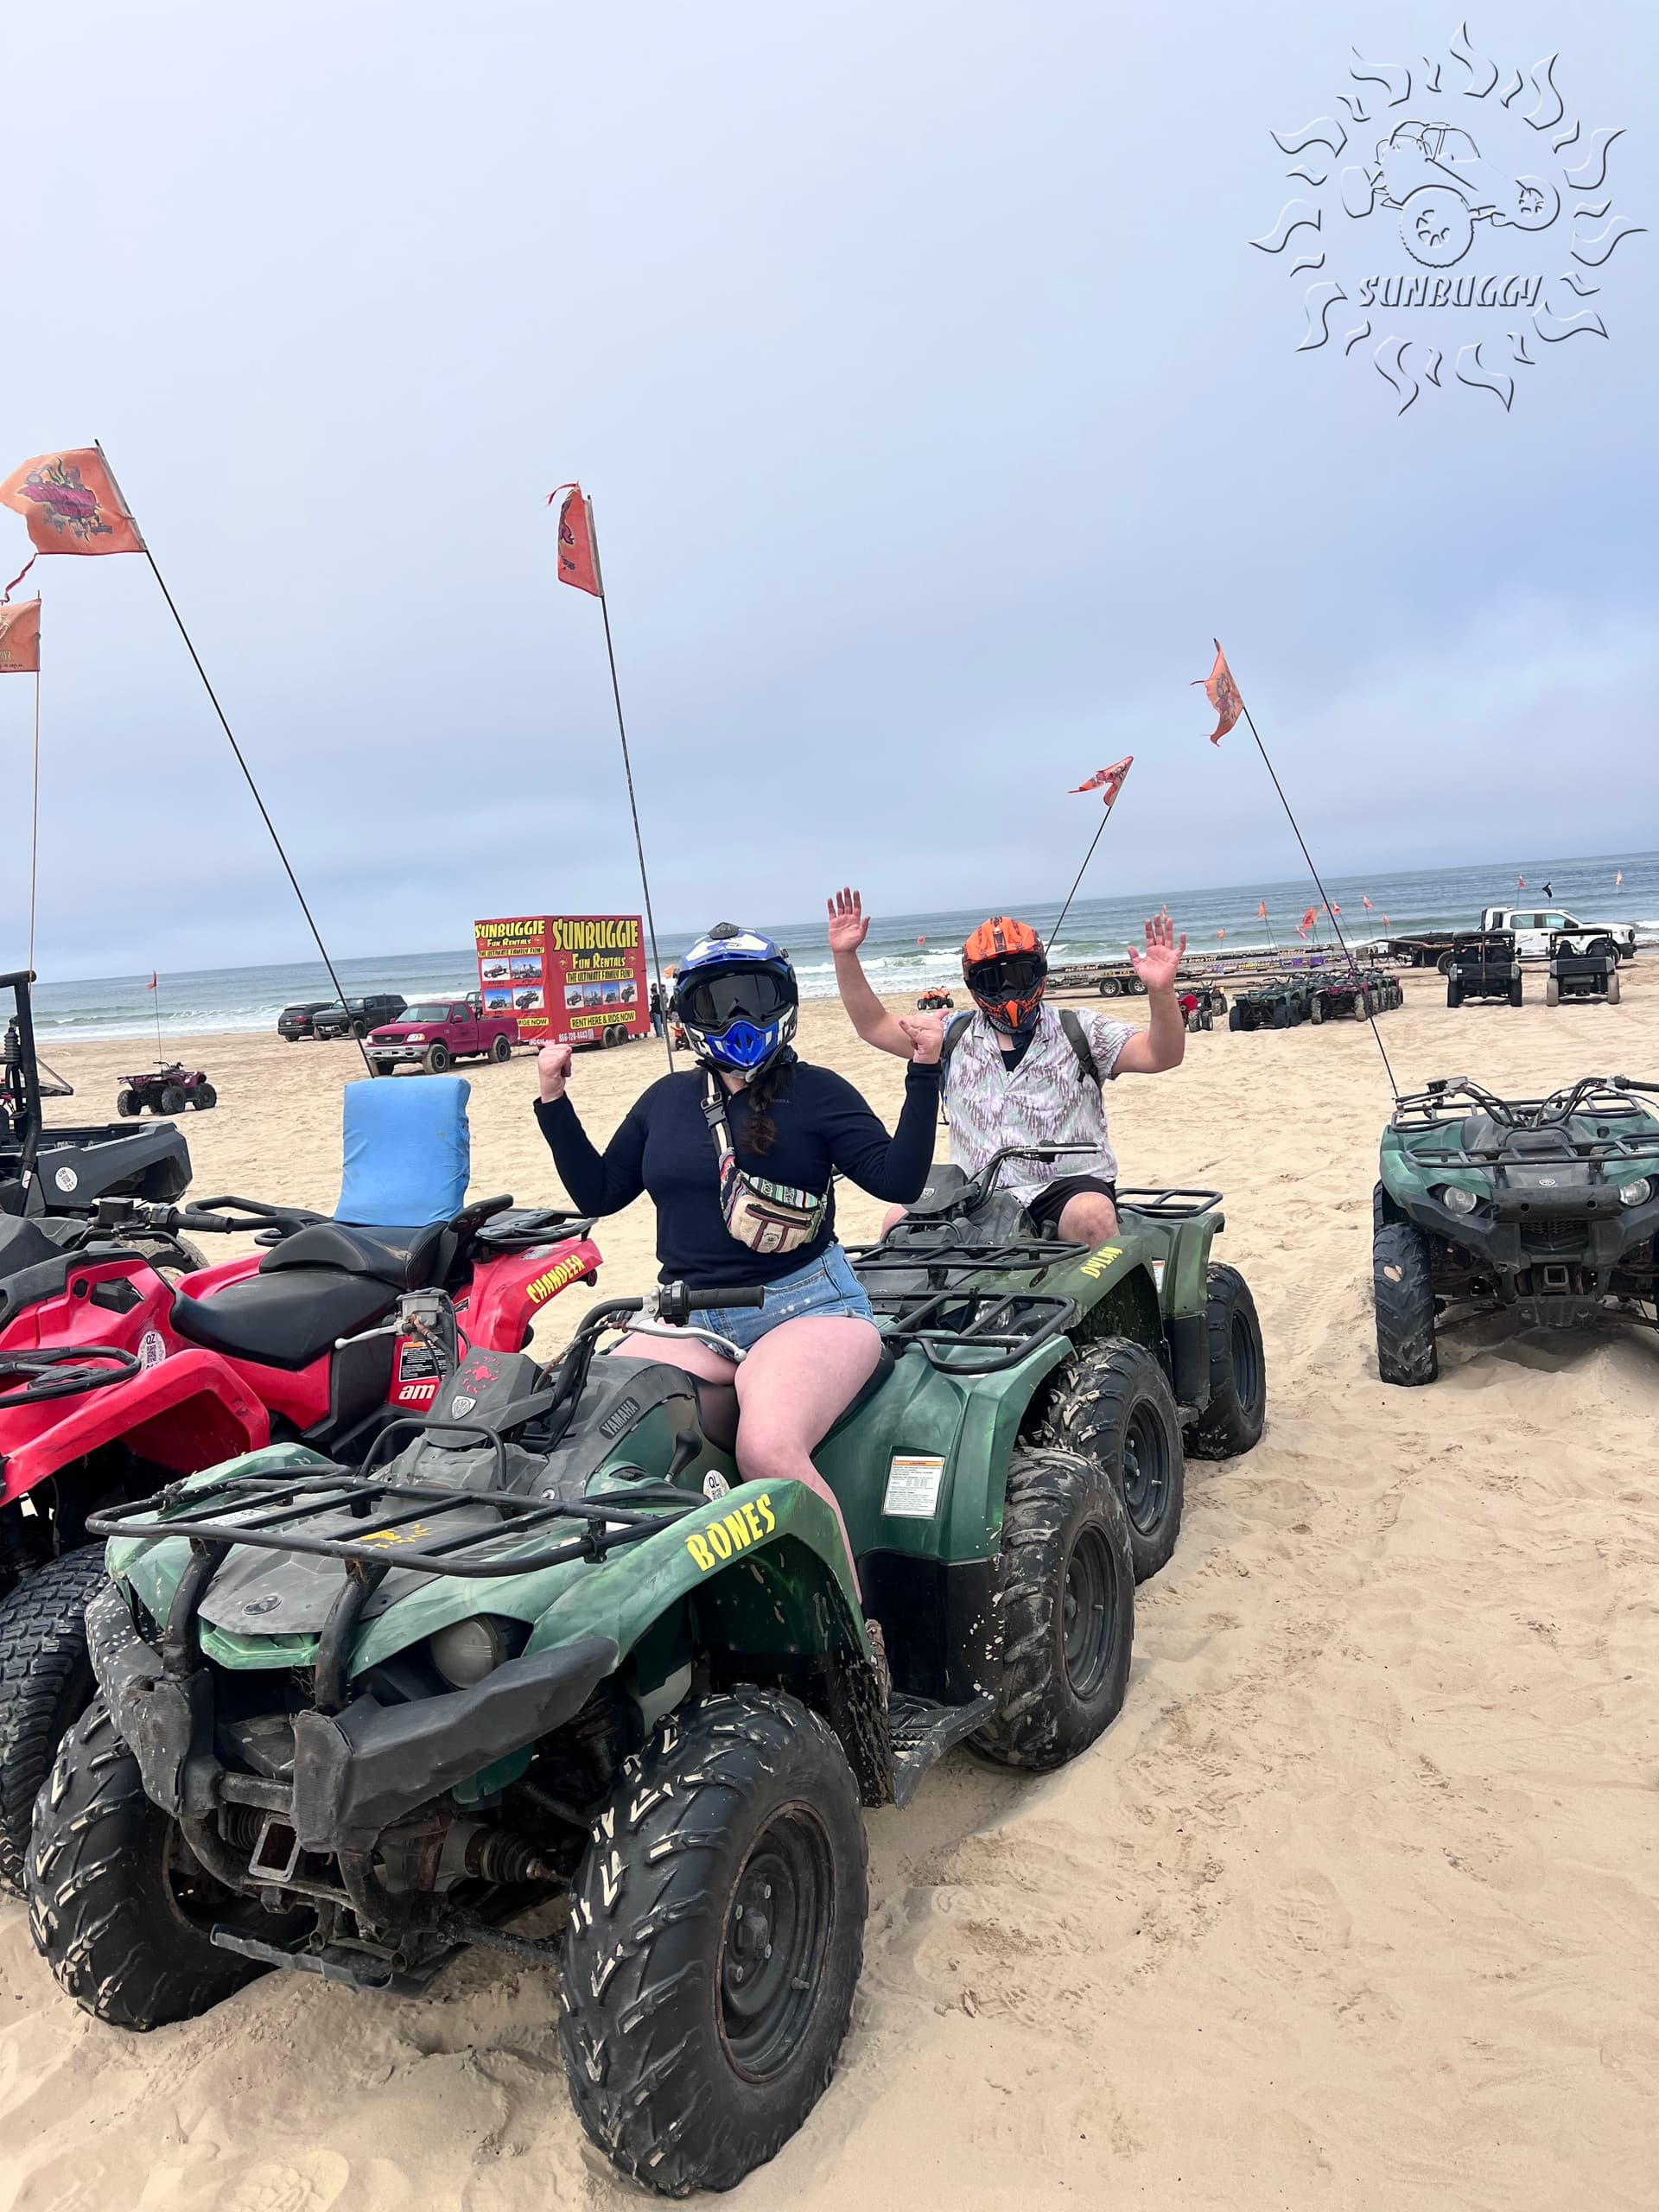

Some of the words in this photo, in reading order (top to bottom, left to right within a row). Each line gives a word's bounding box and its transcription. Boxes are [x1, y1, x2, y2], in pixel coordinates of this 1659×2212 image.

[474, 920, 545, 939] SUNBUGGIE
[553, 918, 639, 950] SUNBUGGIE
[503, 938, 531, 947] RENTALS
[572, 953, 590, 969] FUN
[593, 952, 626, 968] RENTALS
[568, 973, 577, 982] THE
[577, 971, 601, 982] ULTIMATE
[601, 969, 619, 980] FAMILY
[572, 1018, 587, 1027] RENT
[588, 1015, 603, 1026] HERE
[603, 1015, 607, 1024] &
[607, 1014, 620, 1023] RIDE
[620, 1012, 635, 1021] NOW
[1080, 1246, 1123, 1279] DYLAN
[525, 1254, 586, 1304] CHANDLER
[146, 1334, 156, 1345] QZ
[398, 1384, 435, 1400] am
[601, 1400, 639, 1435] YAMAHA
[709, 1476, 720, 1488] QL
[684, 1493, 776, 1572] BONES
